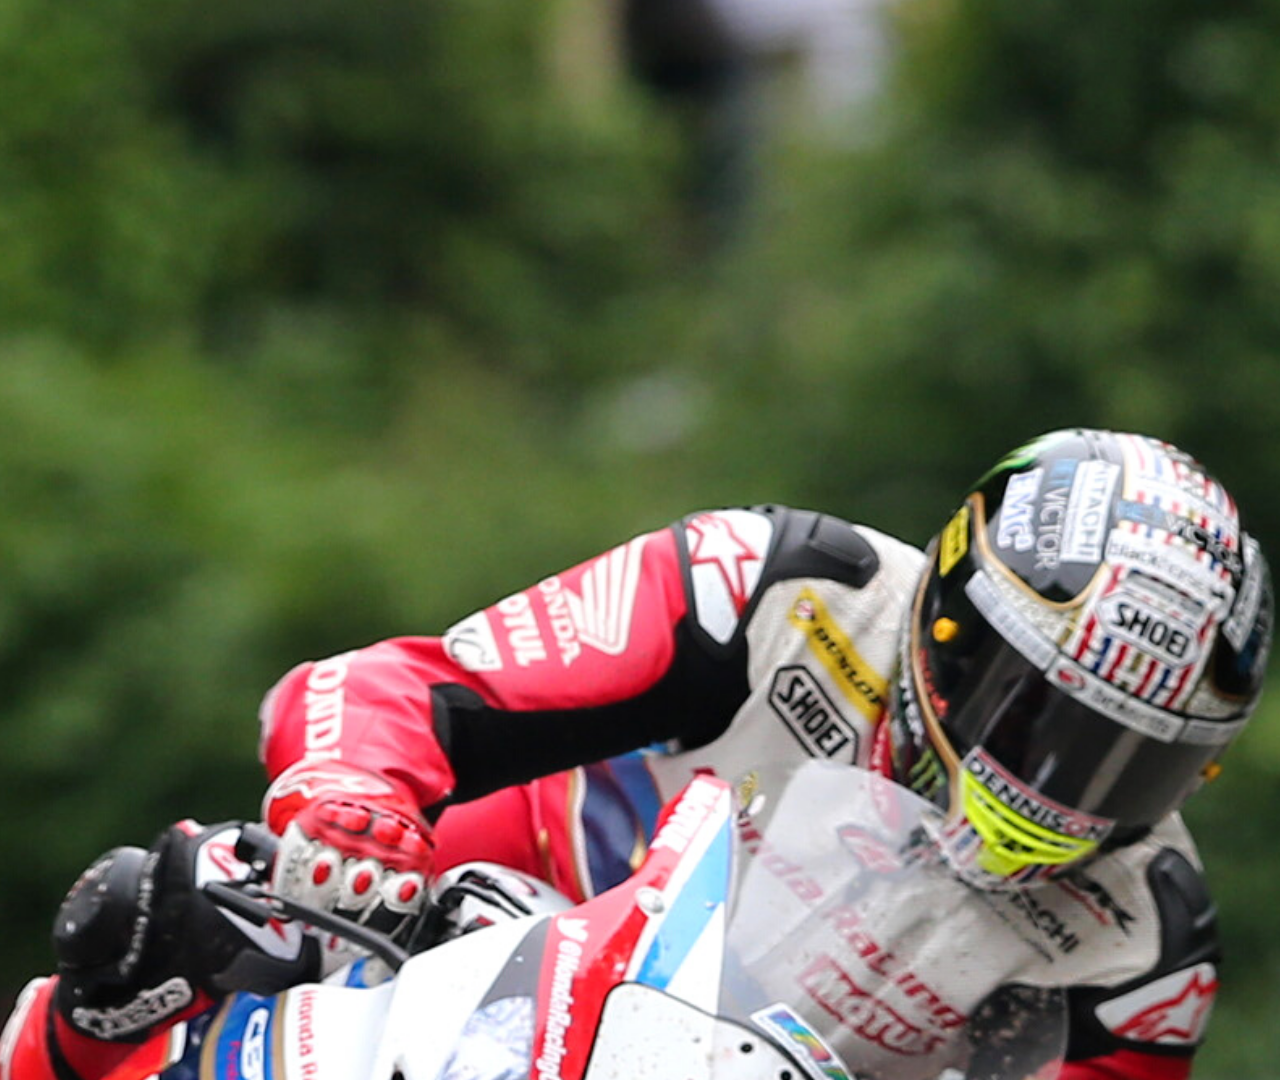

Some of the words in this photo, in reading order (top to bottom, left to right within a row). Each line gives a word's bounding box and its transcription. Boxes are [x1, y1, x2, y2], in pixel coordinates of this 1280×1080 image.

[1034, 486, 1070, 571] VICTOR
[496, 592, 547, 666] OTUL
[537, 575, 581, 668] ONDA
[1112, 602, 1190, 659] SHOEI
[777, 676, 850, 758] SHOEI
[967, 756, 1102, 842] DENNISON
[299, 989, 315, 1058] Honda
